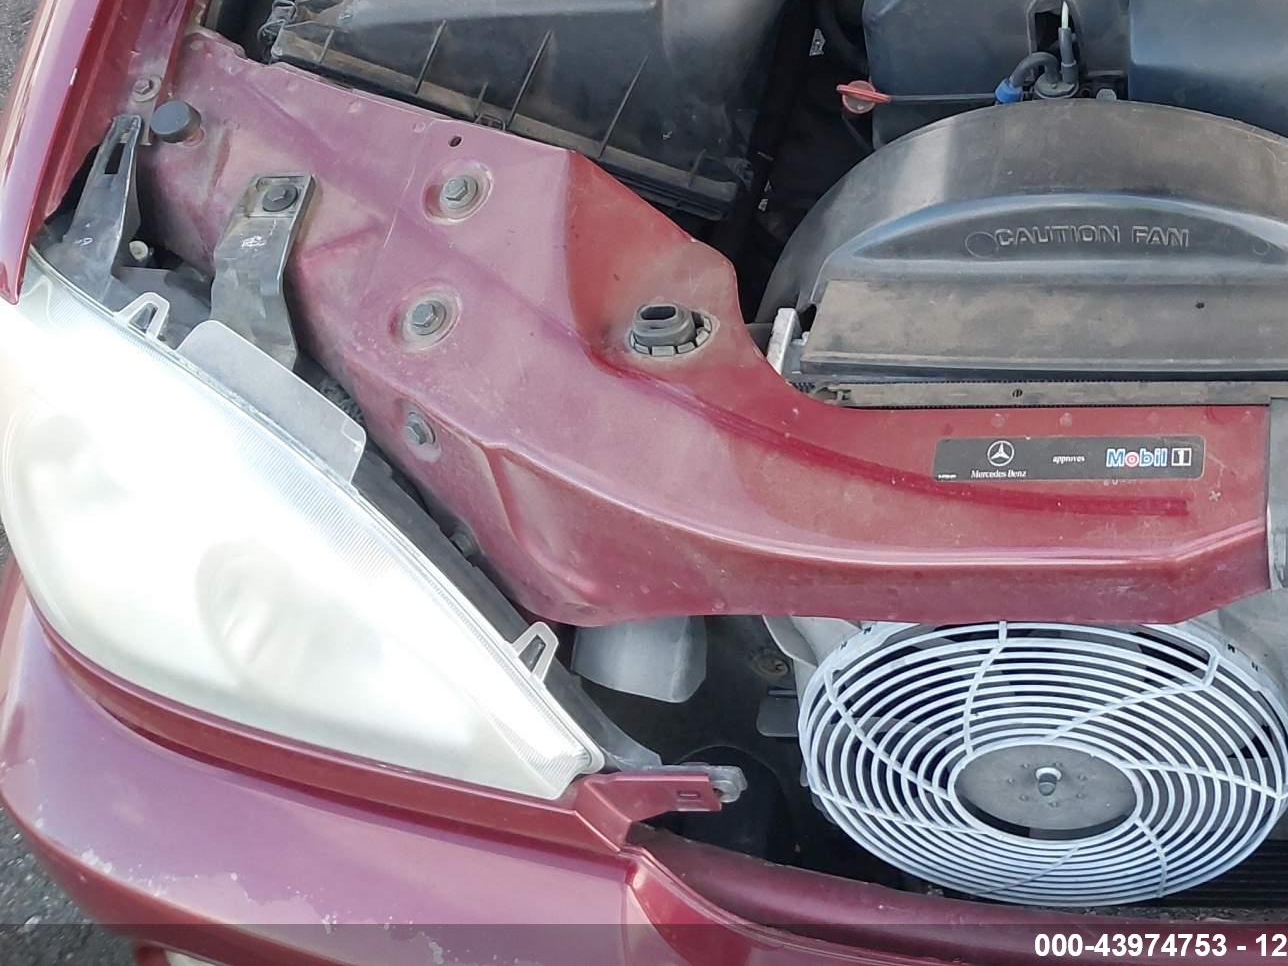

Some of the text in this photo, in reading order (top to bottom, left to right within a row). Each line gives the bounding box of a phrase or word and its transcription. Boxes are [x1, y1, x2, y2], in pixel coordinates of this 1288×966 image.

[994, 225, 1189, 247] CAUTION FAN
[1053, 455, 1085, 464] approves
[1106, 447, 1168, 467] Mobil
